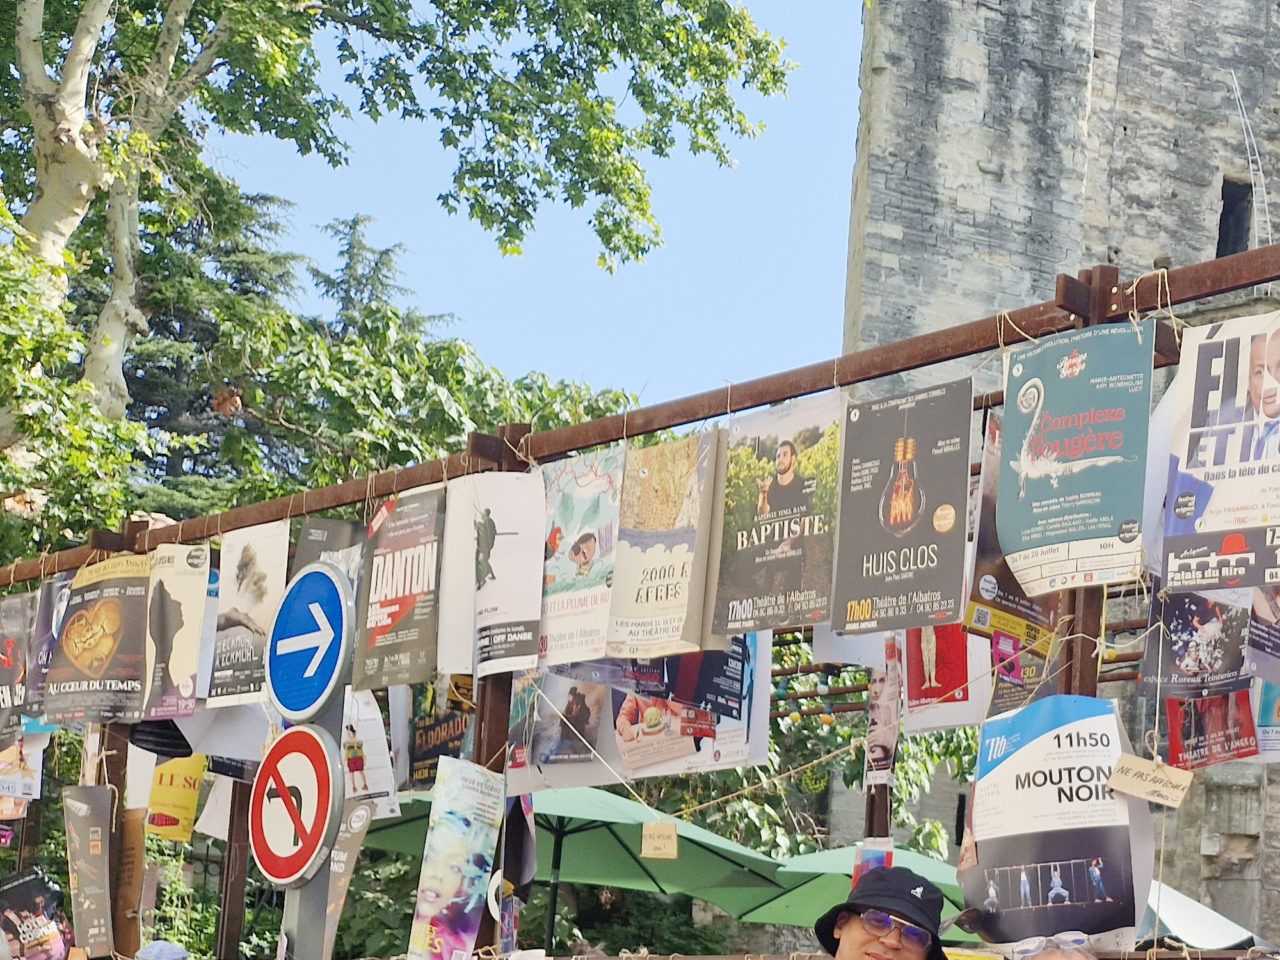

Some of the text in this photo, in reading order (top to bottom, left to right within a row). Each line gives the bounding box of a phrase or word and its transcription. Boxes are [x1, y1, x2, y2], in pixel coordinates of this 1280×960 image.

[1040, 405, 1126, 433] Complexe
[1031, 428, 1124, 462] Fougère
[1204, 468, 1226, 482] Dans
[1228, 468, 1236, 478] la
[1238, 466, 1255, 478] tête
[1258, 463, 1269, 474] du
[370, 541, 439, 602] DANTON
[863, 544, 938, 578] HUIS CLOS
[728, 598, 752, 621] 17h00
[846, 598, 872, 622] 17h00
[90, 679, 142, 692] DU TEMPS
[1053, 732, 1110, 748] 11h50
[1015, 765, 1113, 790] MOUTON
[1116, 765, 1132, 777] NE
[1057, 785, 1115, 803] NOIR
